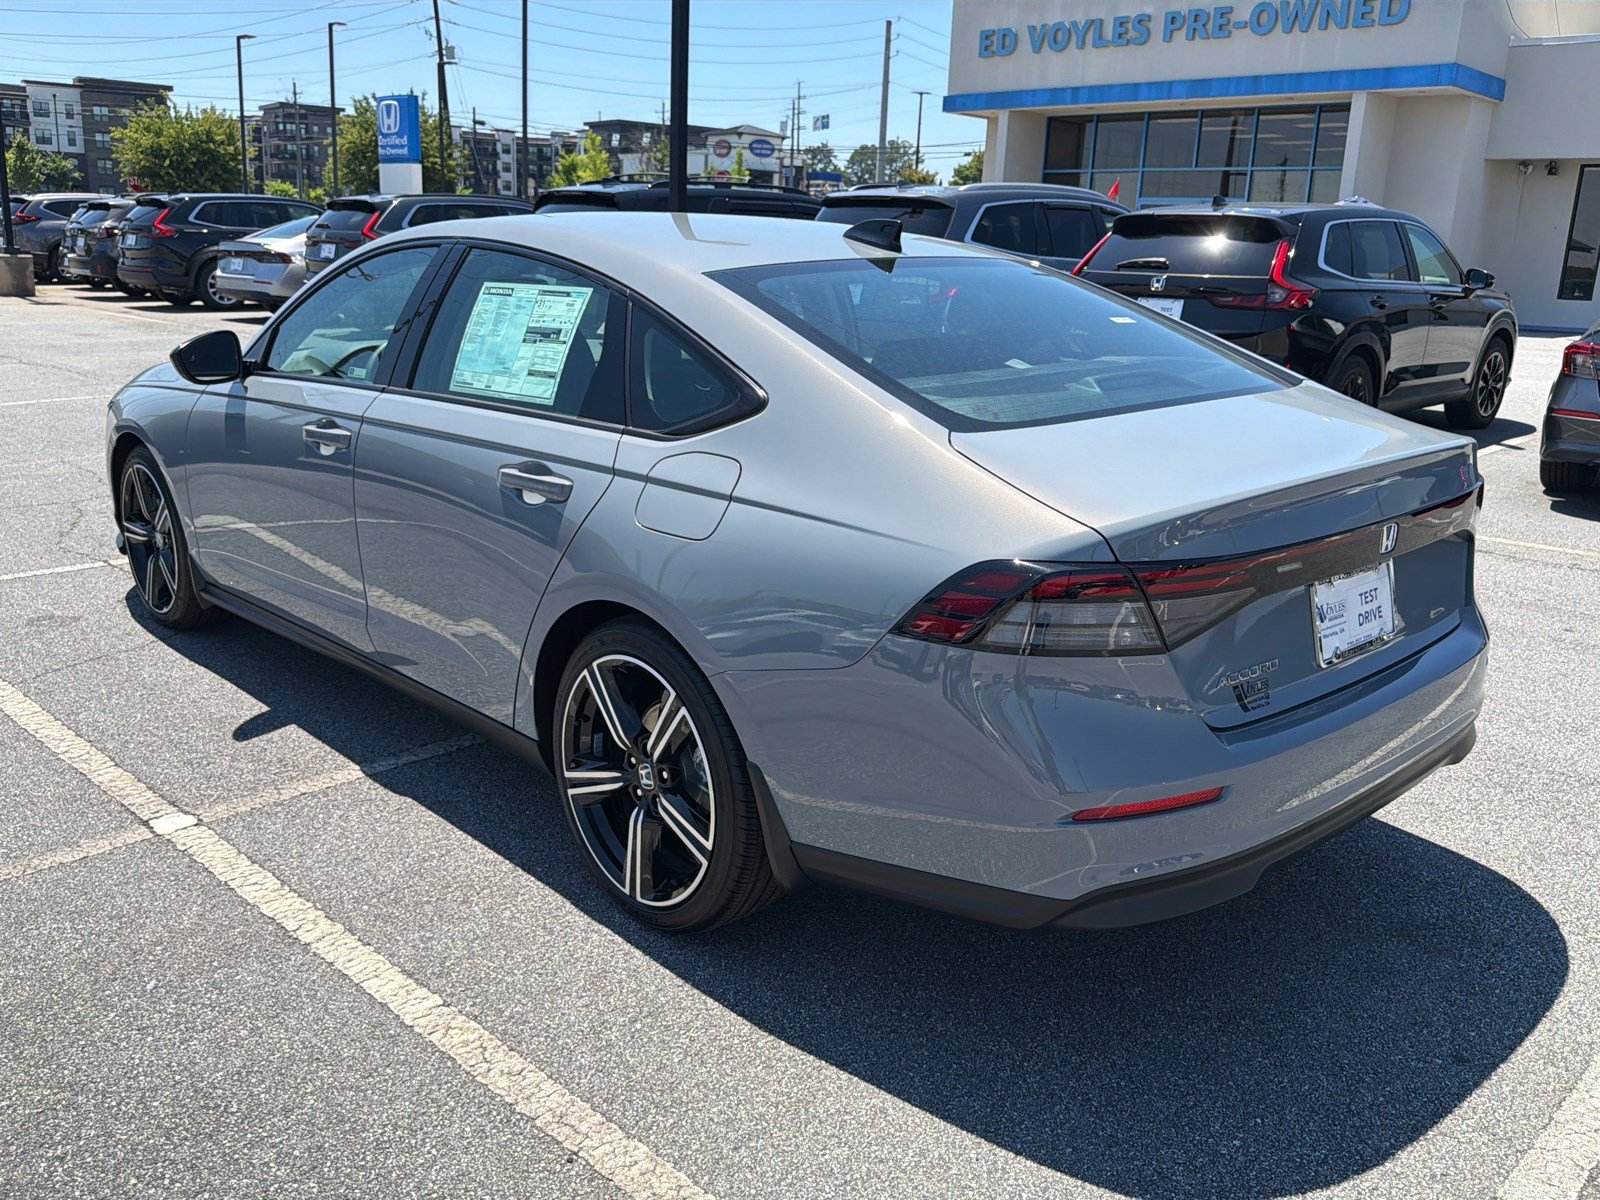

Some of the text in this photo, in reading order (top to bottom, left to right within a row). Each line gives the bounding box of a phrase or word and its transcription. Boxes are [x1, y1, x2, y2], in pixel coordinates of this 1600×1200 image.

[978, 0, 1412, 59] ED VOYLES PRE-OWNED
[1358, 587, 1378, 606] TEST
[1320, 600, 1346, 620] VOYLES
[1357, 605, 1383, 627] DRIVE
[1217, 659, 1280, 687] ACCORD
